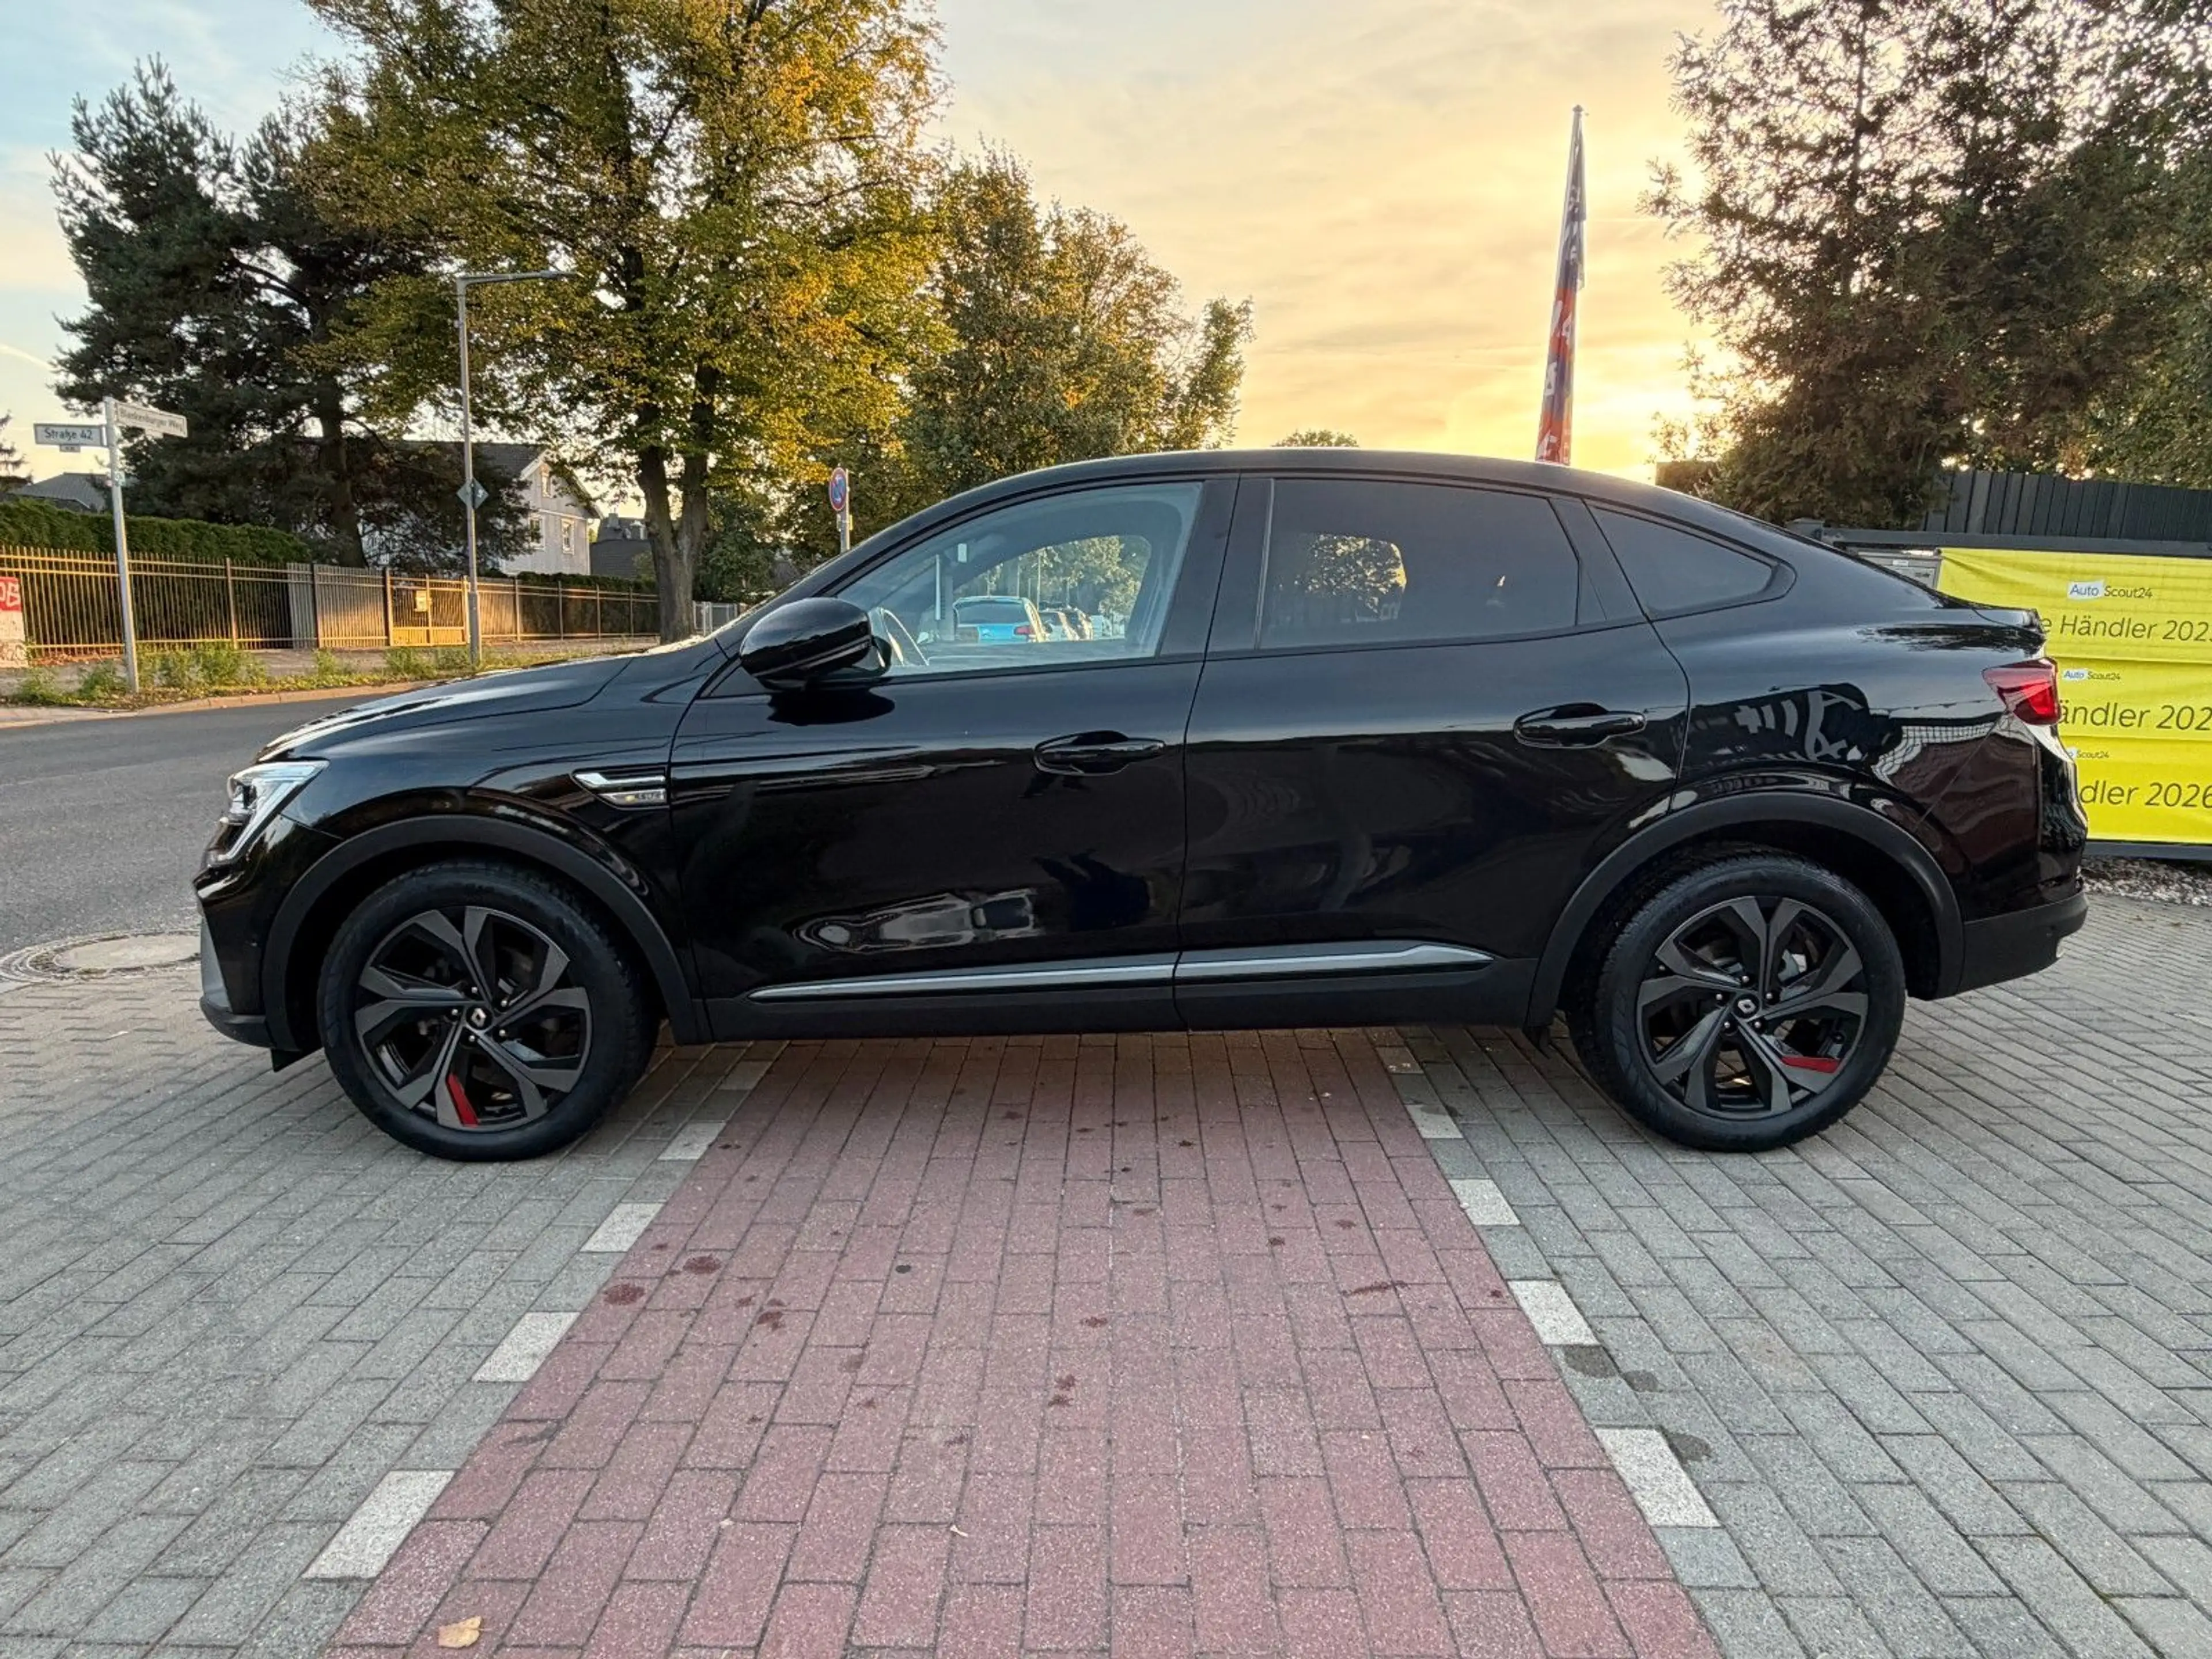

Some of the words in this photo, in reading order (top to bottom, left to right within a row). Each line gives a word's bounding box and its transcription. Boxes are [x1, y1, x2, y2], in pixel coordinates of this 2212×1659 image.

[44, 429, 77, 441] Straße
[79, 430, 93, 440] 42
[2069, 584, 2100, 597] Auto
[2104, 585, 2153, 599] Scout24
[2040, 618, 2052, 634] e
[2060, 614, 2158, 639] Händler
[2162, 619, 2212, 642] 202
[2063, 671, 2084, 679] Auto
[2087, 671, 2121, 680] Scout24
[2060, 699, 2151, 728] ändler
[2156, 704, 2212, 731] 202
[2076, 749, 2110, 759] Scout24
[2079, 780, 2139, 805] dler
